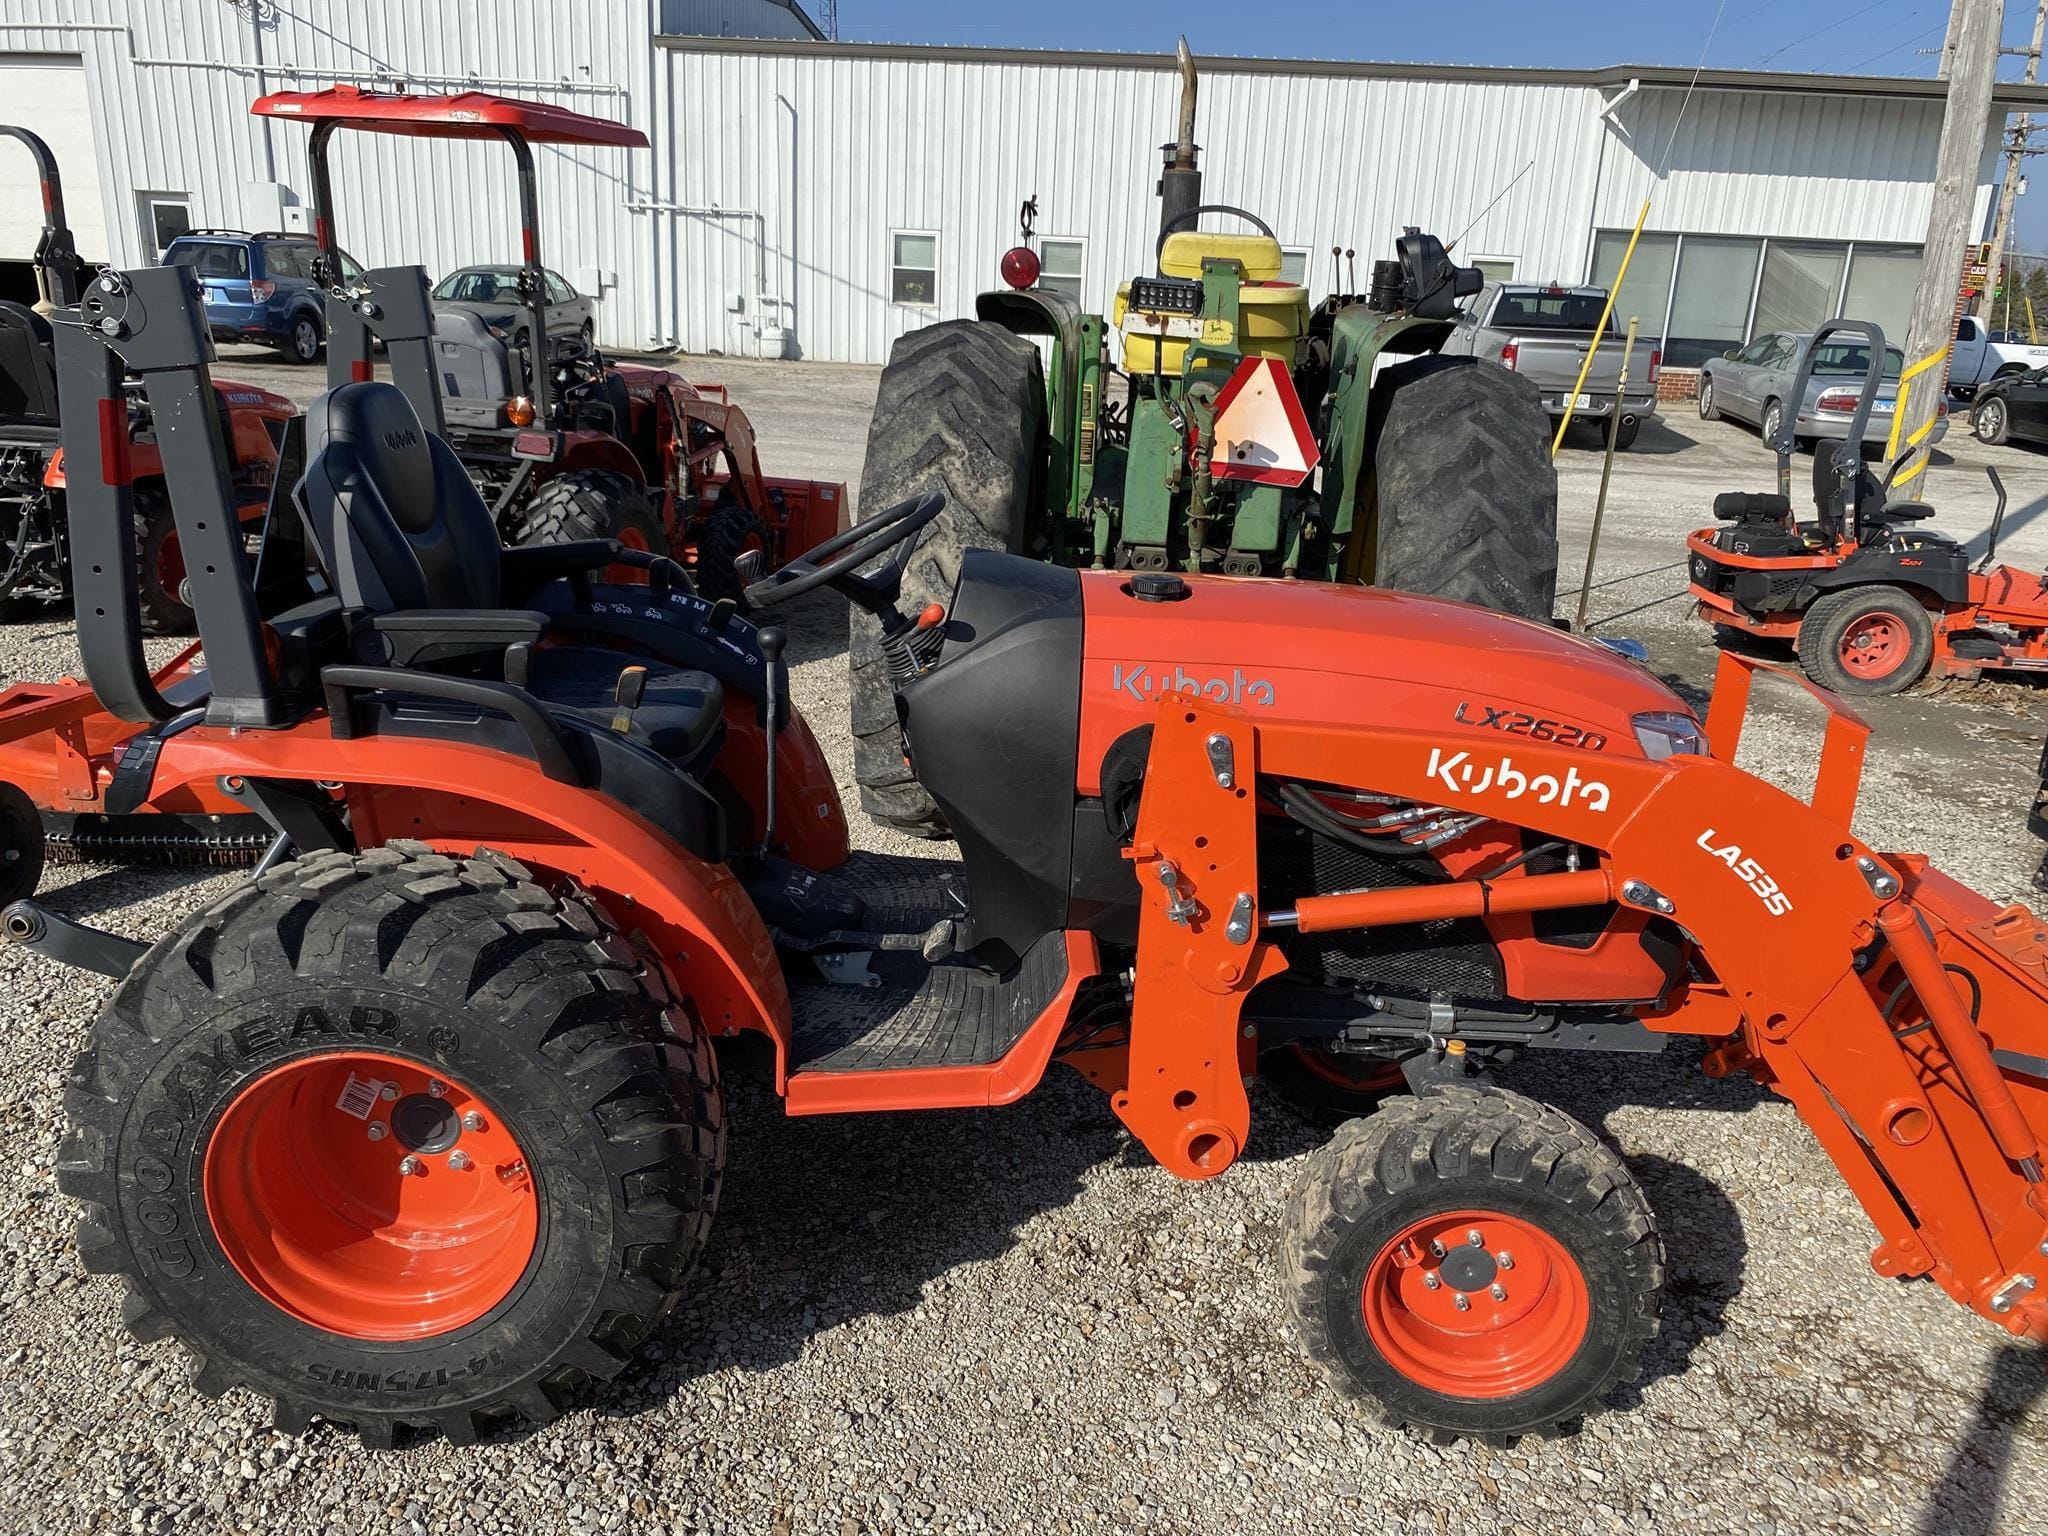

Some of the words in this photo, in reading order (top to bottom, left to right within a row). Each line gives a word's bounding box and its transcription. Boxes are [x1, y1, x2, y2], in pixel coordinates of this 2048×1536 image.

[227, 392, 264, 404] KUBOTA
[1113, 664, 1276, 705] Kubota
[1454, 702, 1608, 751] LX2620
[1426, 748, 1611, 812] Kubota
[1696, 828, 1794, 916] LA535
[133, 1004, 401, 1278] GOODYEAR
[306, 1347, 504, 1393] 14-17.5NHS
